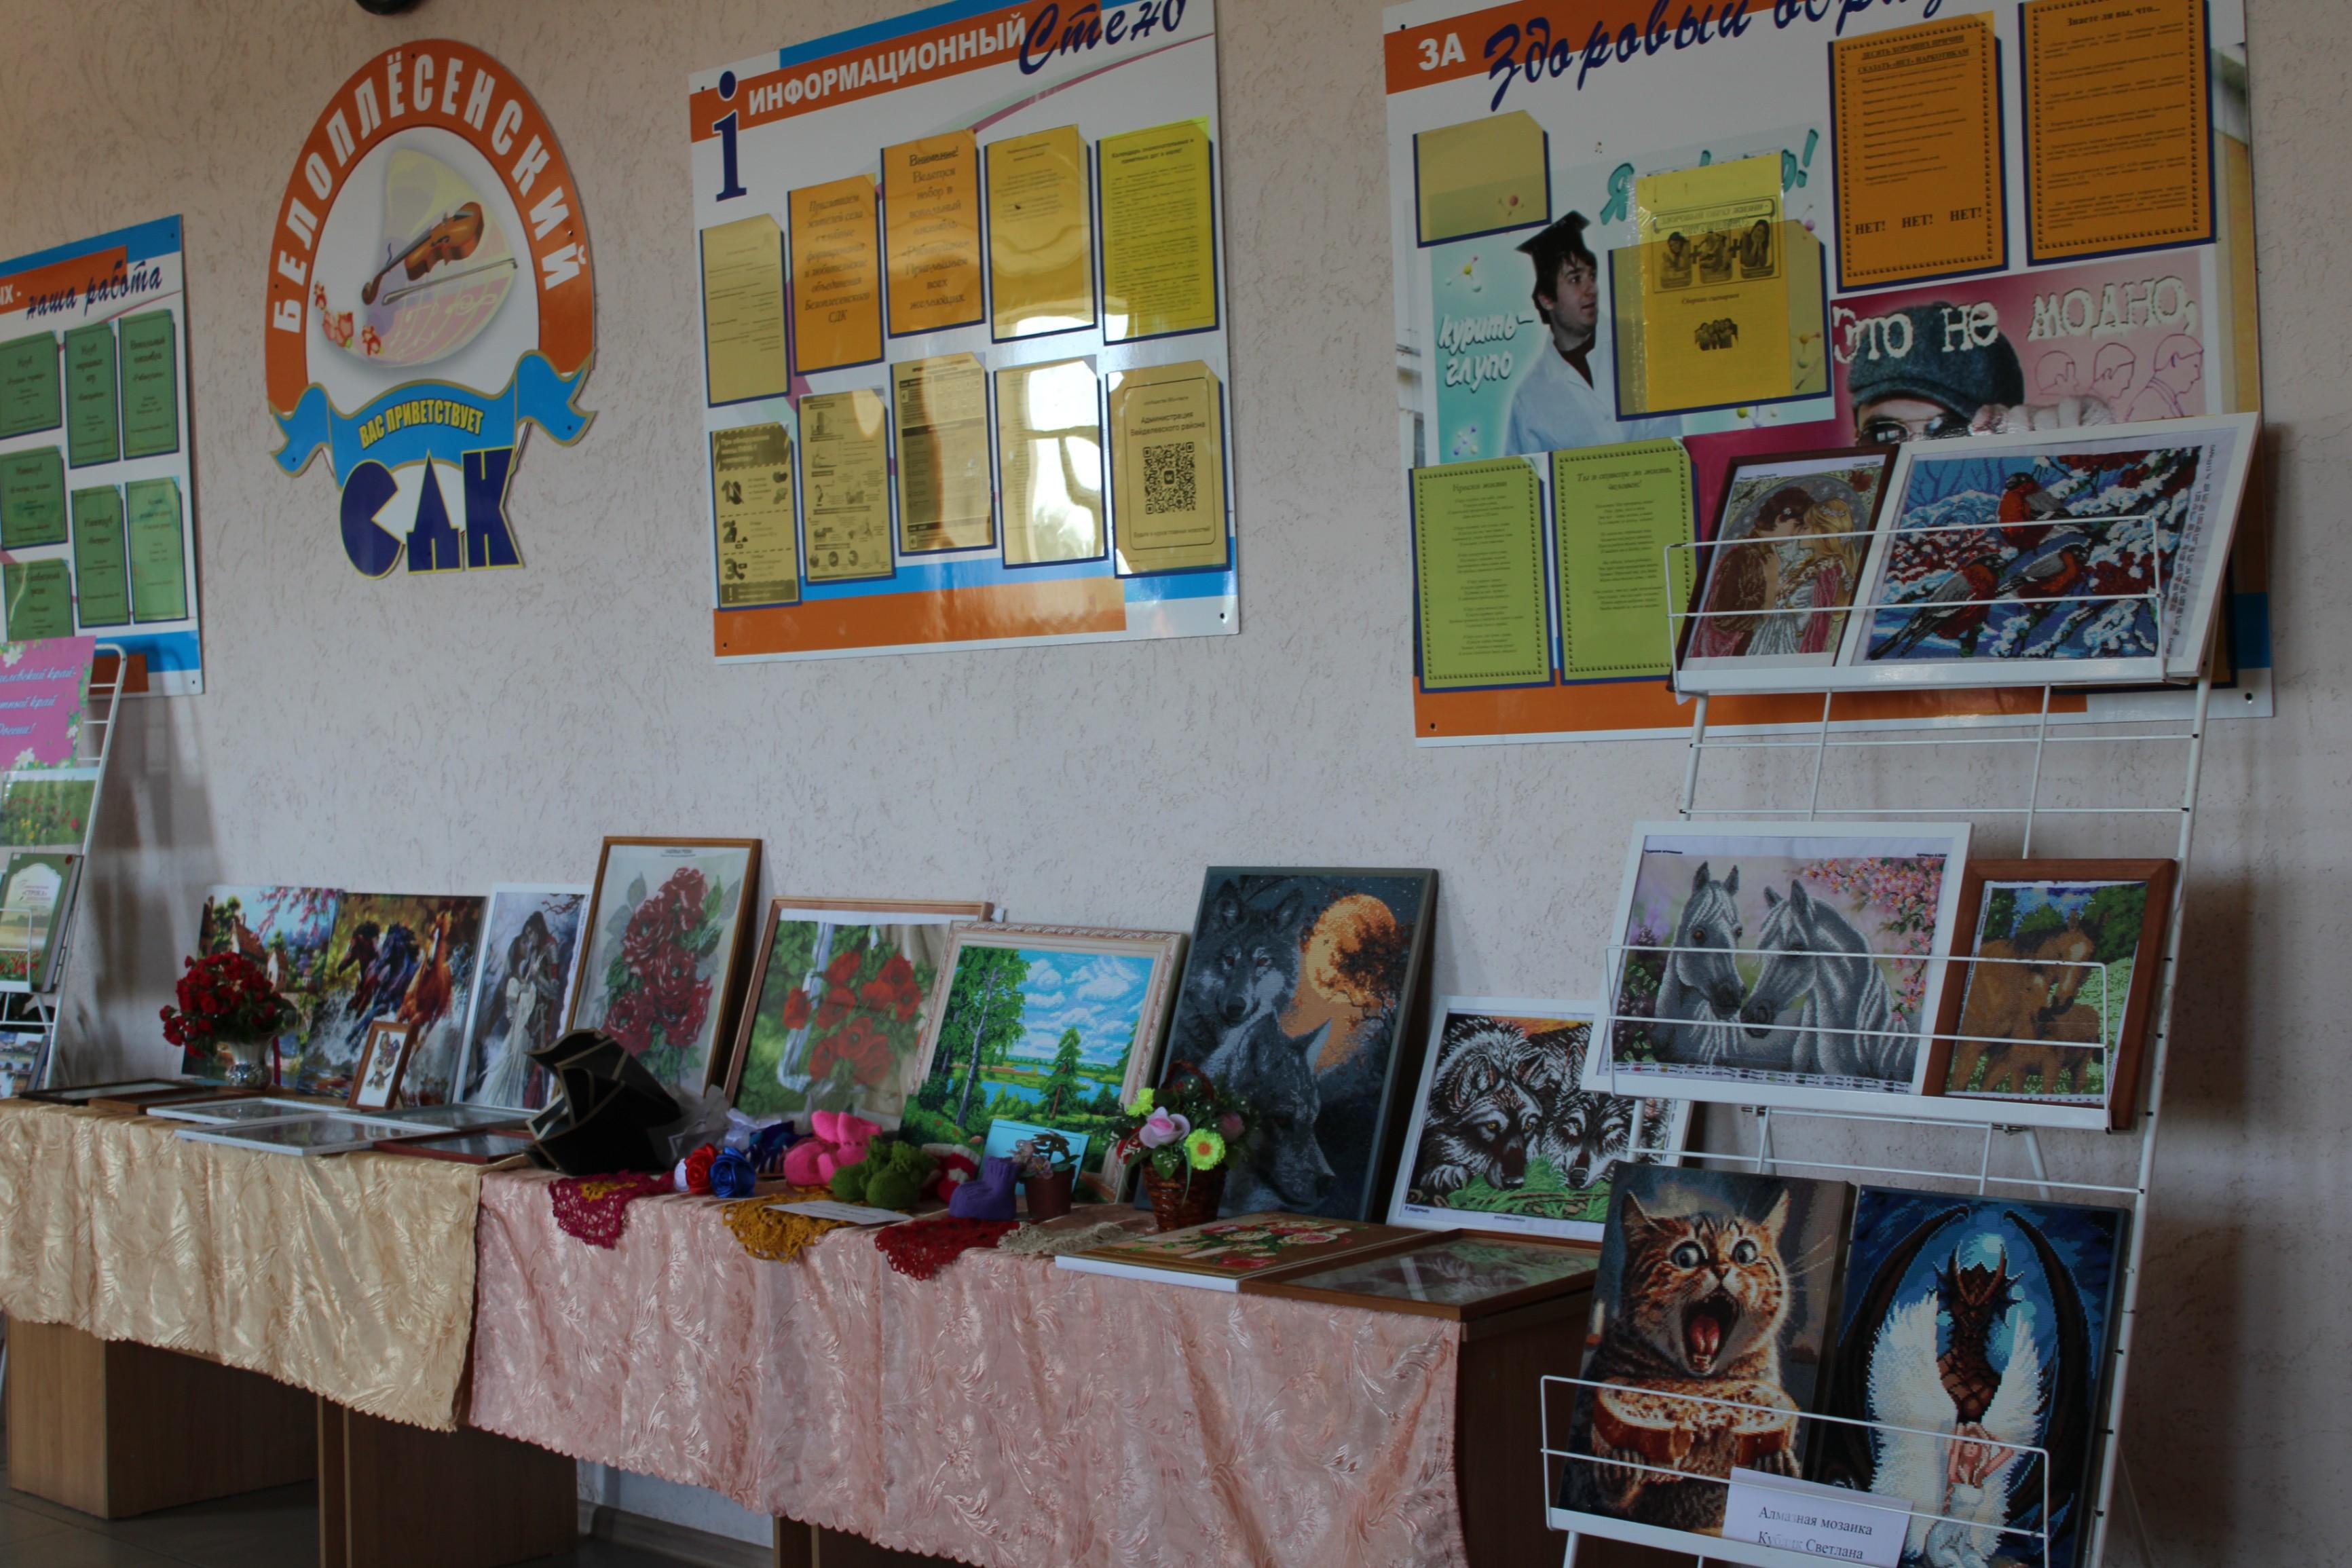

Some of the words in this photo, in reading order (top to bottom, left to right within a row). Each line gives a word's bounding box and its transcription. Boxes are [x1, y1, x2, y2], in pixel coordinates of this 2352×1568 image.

[2068, 16, 2098, 26] Знаете
[1417, 33, 1466, 72] ЗА
[1862, 49, 1890, 59] ДЕСЯТЬ
[1892, 41, 1930, 54] ХОРОШИХ
[1932, 35, 1964, 47] ПРИЧИН
[749, 12, 1026, 116] ИНФОРМАЦИОННЫЙ
[1858, 62, 1890, 73] СКАЗАТЬ
[1916, 48, 1969, 62] НАРКОТИКАМ
[910, 147, 958, 167] Внимание!
[913, 167, 956, 183] Ведется
[274, 52, 586, 333] БЕЛОПЛЁСЕНСКИЙ
[917, 186, 944, 201] набор
[809, 194, 859, 213] Приглашаем
[910, 200, 961, 219] вокальный
[808, 212, 842, 228] жителей
[845, 210, 863, 221] села
[1902, 214, 1933, 228] НЕТ!
[1950, 207, 1982, 221] НЕТ!
[1855, 221, 1886, 235] НЕТ!
[906, 259, 968, 277] Приглашаем
[26, 286, 77, 320] наша
[84, 259, 162, 317] работа
[927, 278, 948, 289] всех
[910, 293, 965, 310] желающих
[828, 310, 847, 323] СДК
[359, 416, 386, 451] ВАС
[385, 399, 485, 438] ПРИВЕТСТВУЕТ
[1141, 411, 1193, 424] Администрация
[1130, 425, 1180, 436] Вейделевского
[1180, 420, 1206, 433] района
[339, 449, 524, 580] СДК
[1759, 1506, 1817, 1527] Алмазная
[1820, 1519, 1872, 1535] мозаика
[1806, 1538, 1863, 1560] Светлана
